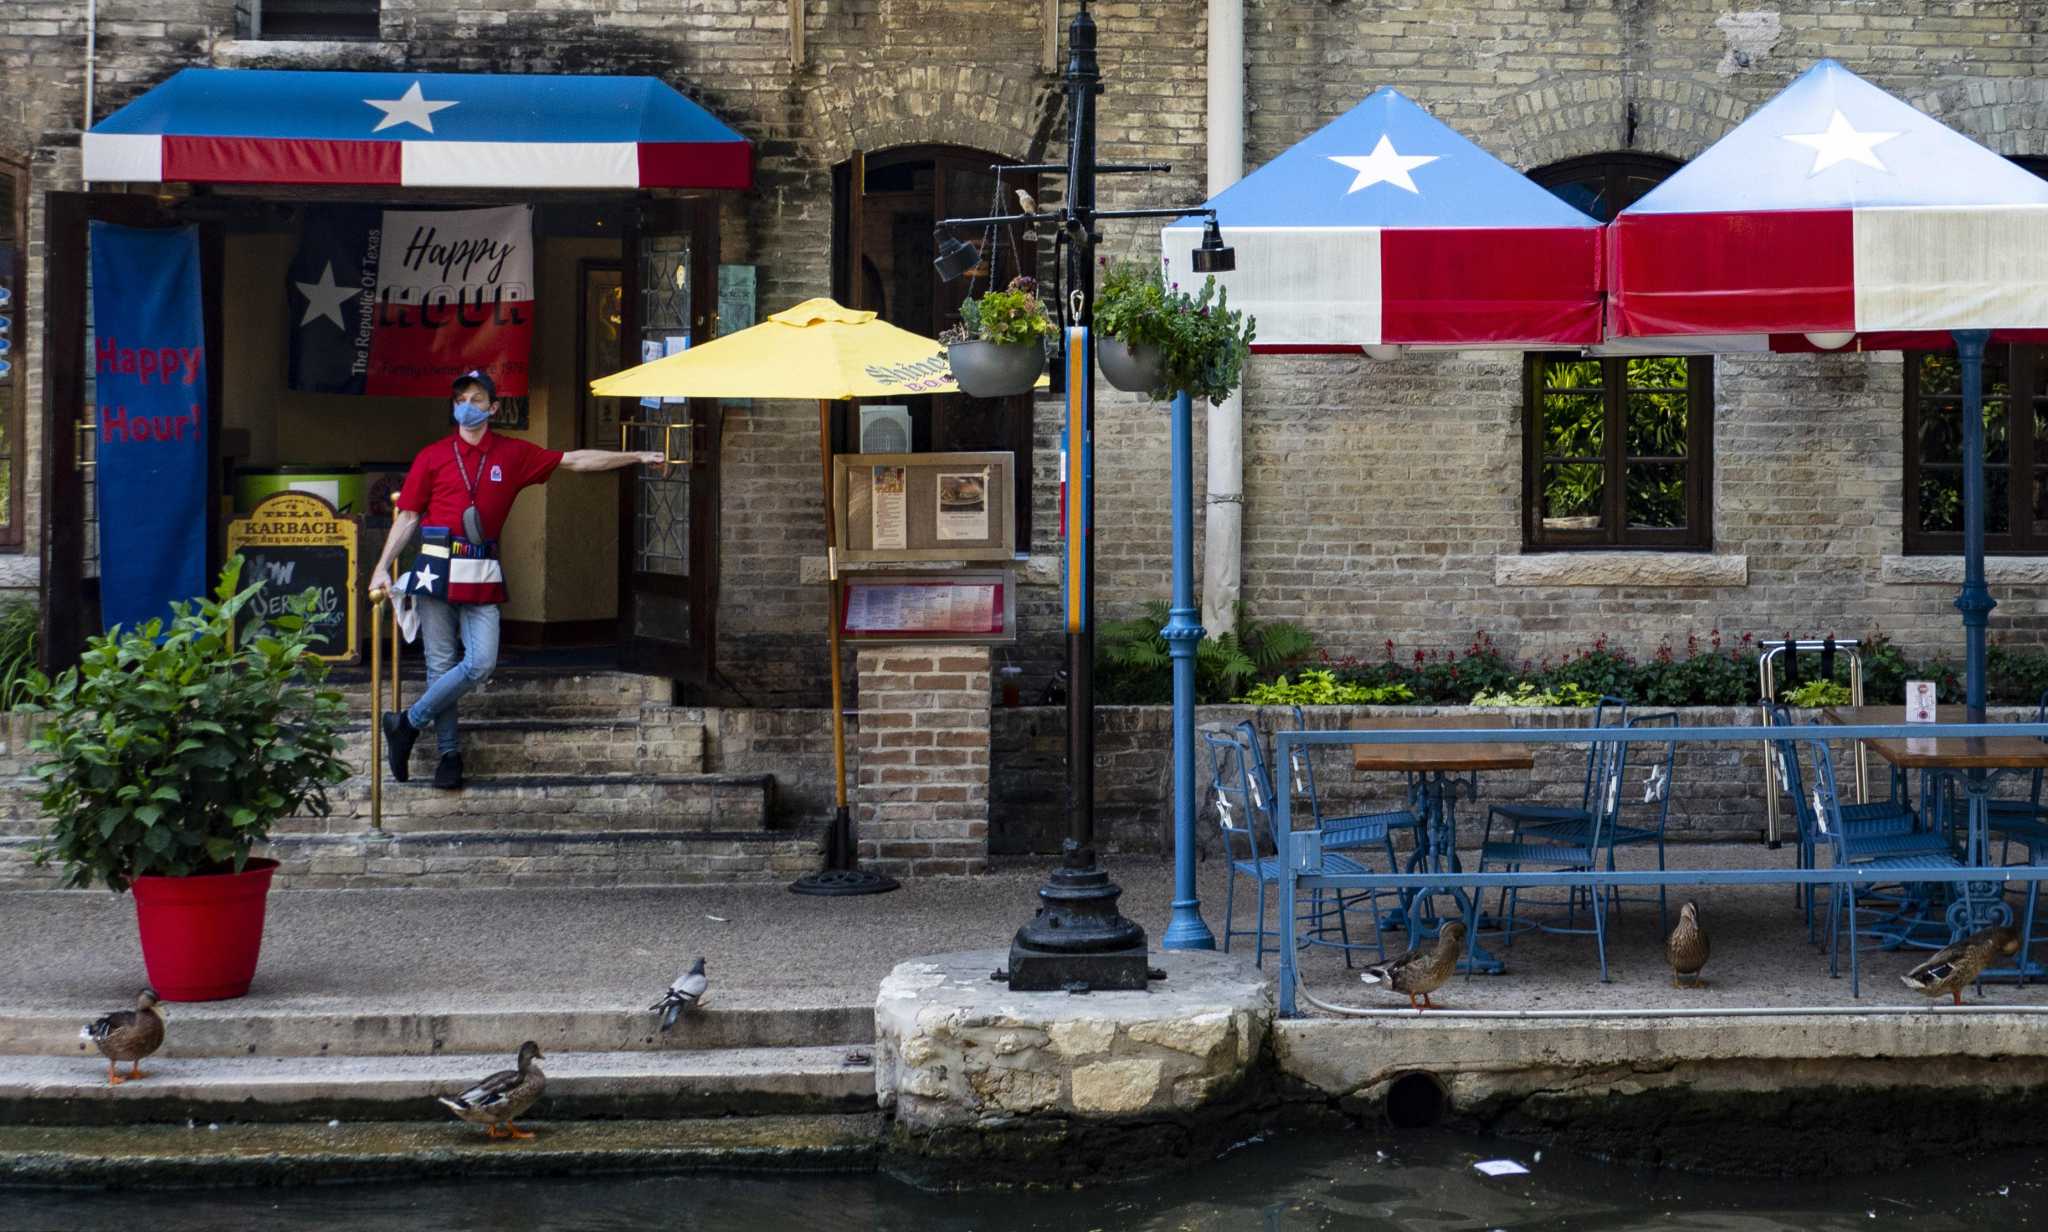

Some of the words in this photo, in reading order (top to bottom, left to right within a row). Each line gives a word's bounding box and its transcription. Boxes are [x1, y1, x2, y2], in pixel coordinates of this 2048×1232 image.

[362, 229, 380, 265] Texas
[402, 225, 517, 284] Happy
[361, 266, 376, 288] Of
[355, 289, 374, 348] Republic
[379, 282, 530, 328] HOUR
[95, 336, 202, 385] Happy
[352, 349, 368, 376] The
[103, 403, 201, 443] Hour!
[244, 521, 339, 535] KARBACH
[259, 535, 310, 543] BREWING
